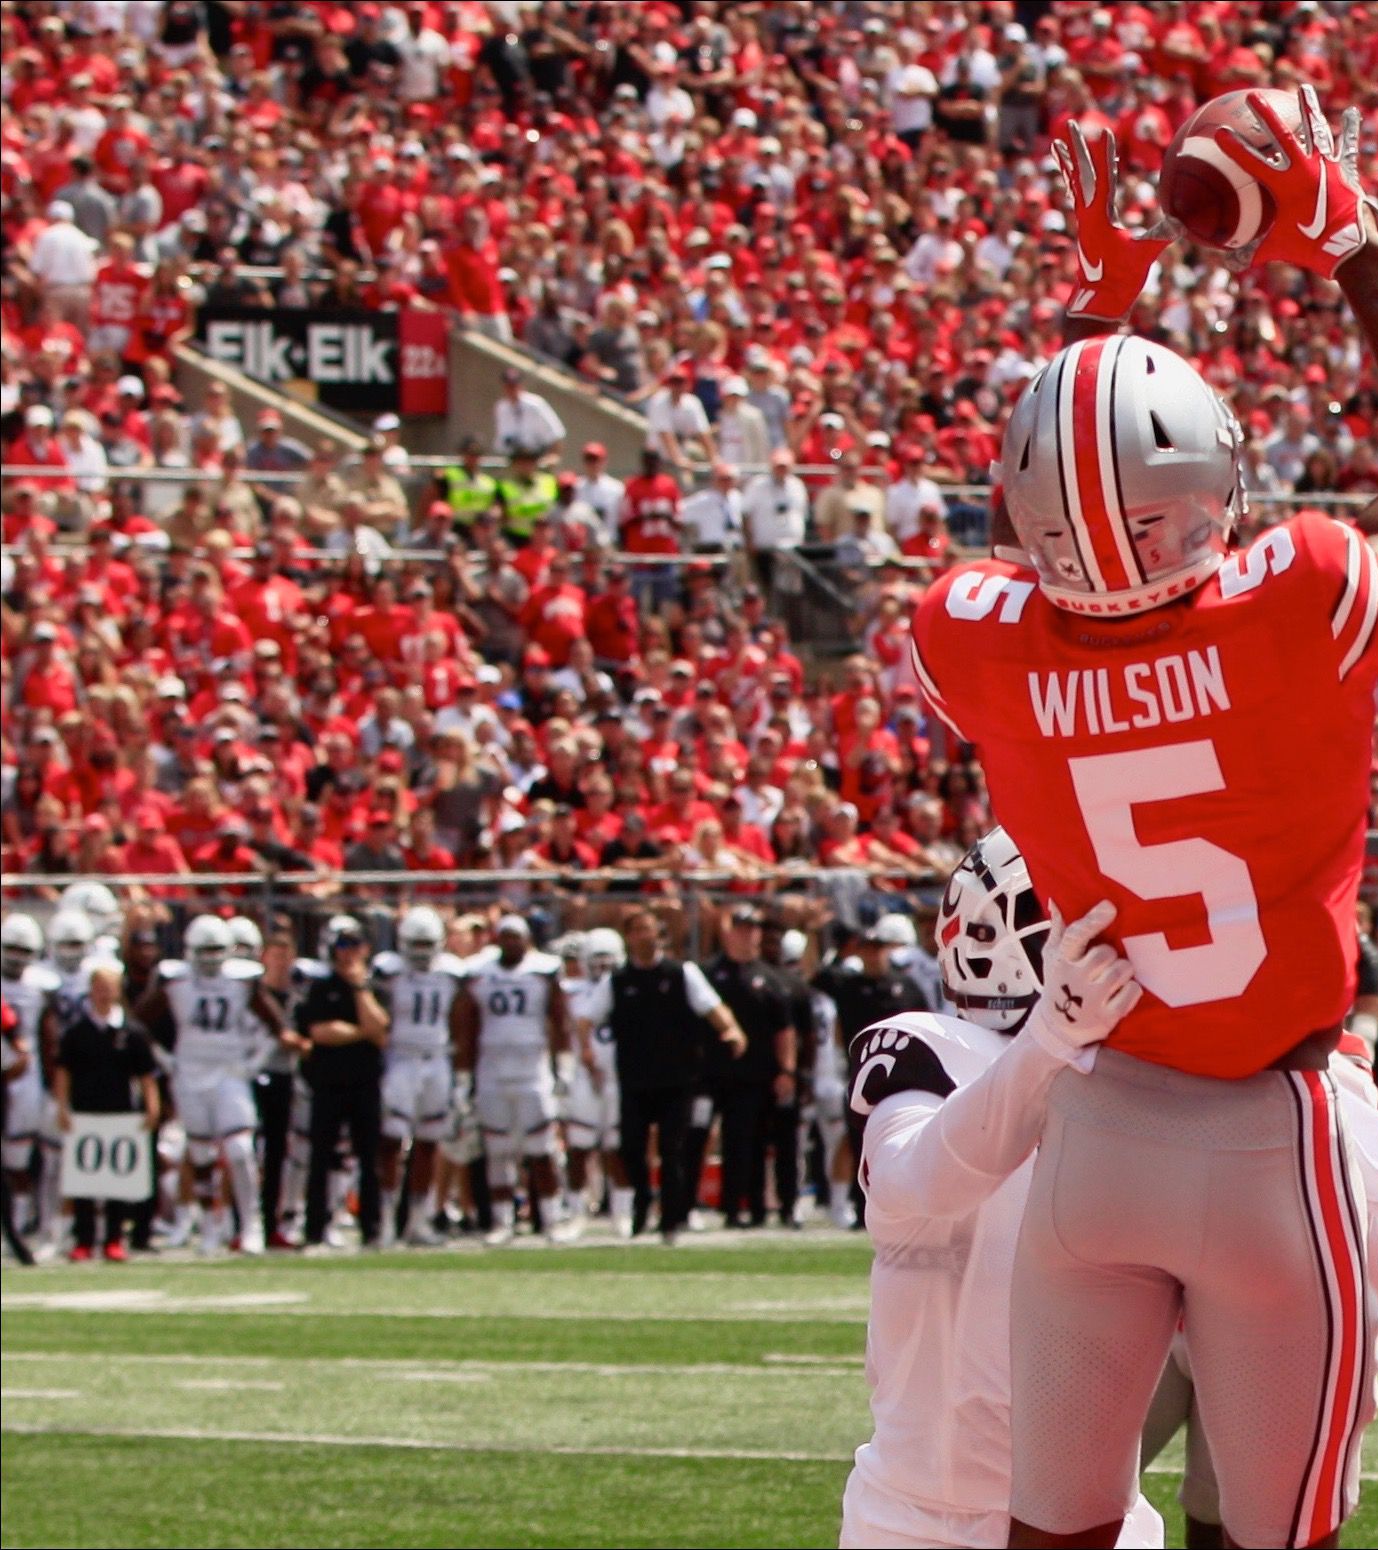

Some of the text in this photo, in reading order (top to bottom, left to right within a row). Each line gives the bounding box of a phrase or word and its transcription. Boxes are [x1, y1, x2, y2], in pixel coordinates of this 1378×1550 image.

[1055, 575, 1198, 614] BUCKEYES
[1218, 526, 1296, 600] 5
[945, 570, 1037, 624] 5
[1028, 645, 1232, 738] WILSON
[1067, 738, 1268, 1009] 5
[76, 1135, 138, 1176] 00
